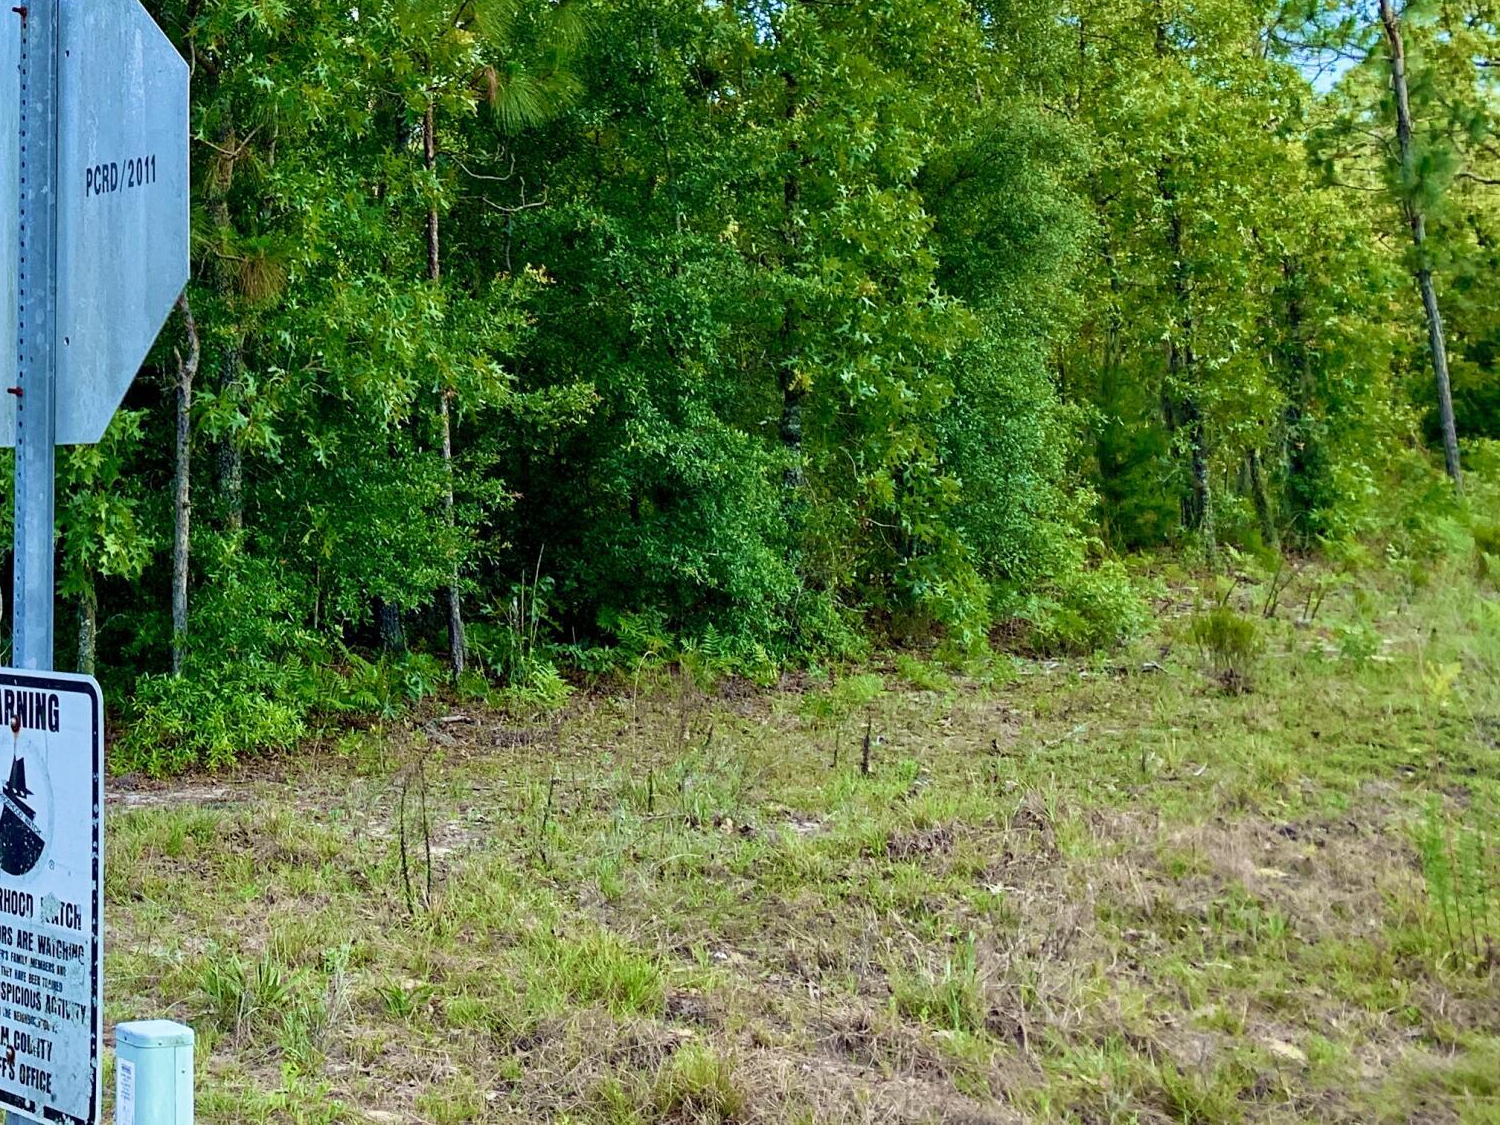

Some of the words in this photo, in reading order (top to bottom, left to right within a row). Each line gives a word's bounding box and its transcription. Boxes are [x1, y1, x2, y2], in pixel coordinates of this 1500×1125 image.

[86, 155, 156, 197] PCRD/2011
[41, 896, 82, 931] TCH
[16, 929, 34, 952] ARE
[37, 934, 85, 966] WATCHING
[45, 994, 86, 1025] ACTIVTY
[19, 1063, 53, 1095] OFFICE
